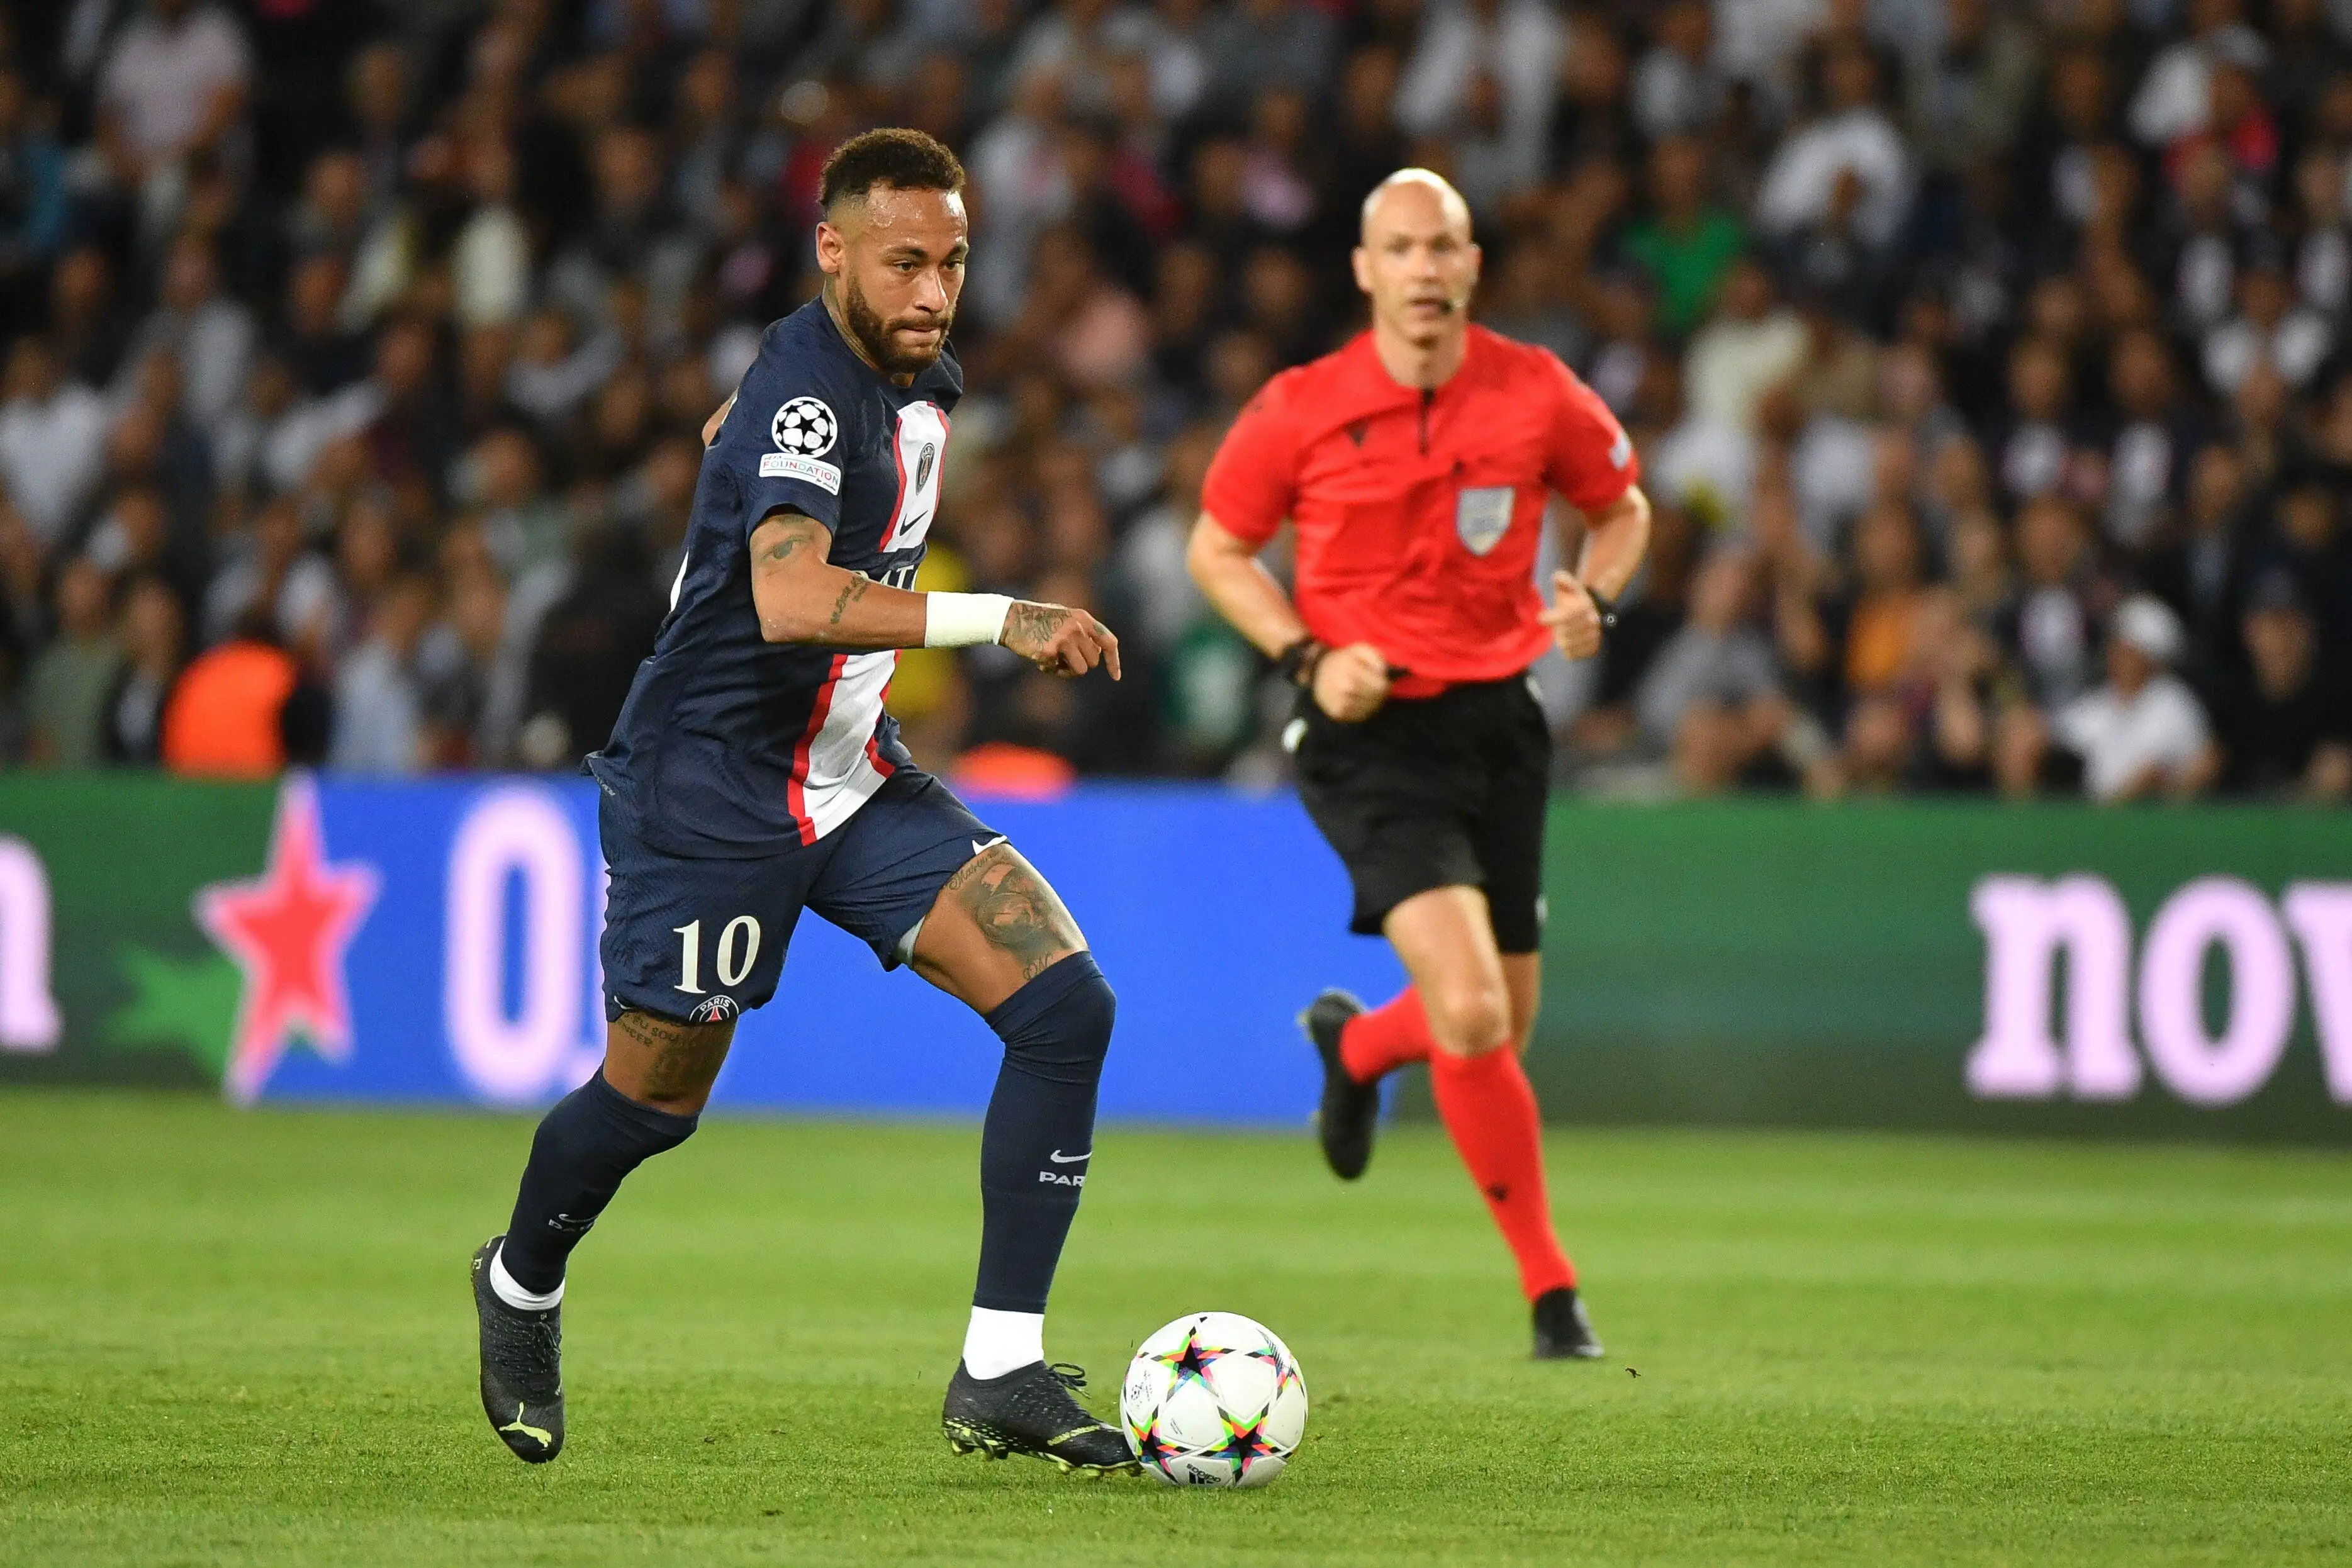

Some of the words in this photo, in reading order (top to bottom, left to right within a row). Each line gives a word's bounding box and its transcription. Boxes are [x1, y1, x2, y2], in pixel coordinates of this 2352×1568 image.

[763, 460, 839, 485] FOUNDATION
[673, 915, 761, 994] 10
[699, 997, 731, 1012] PARIS
[1186, 1464, 1221, 1482] adidas
